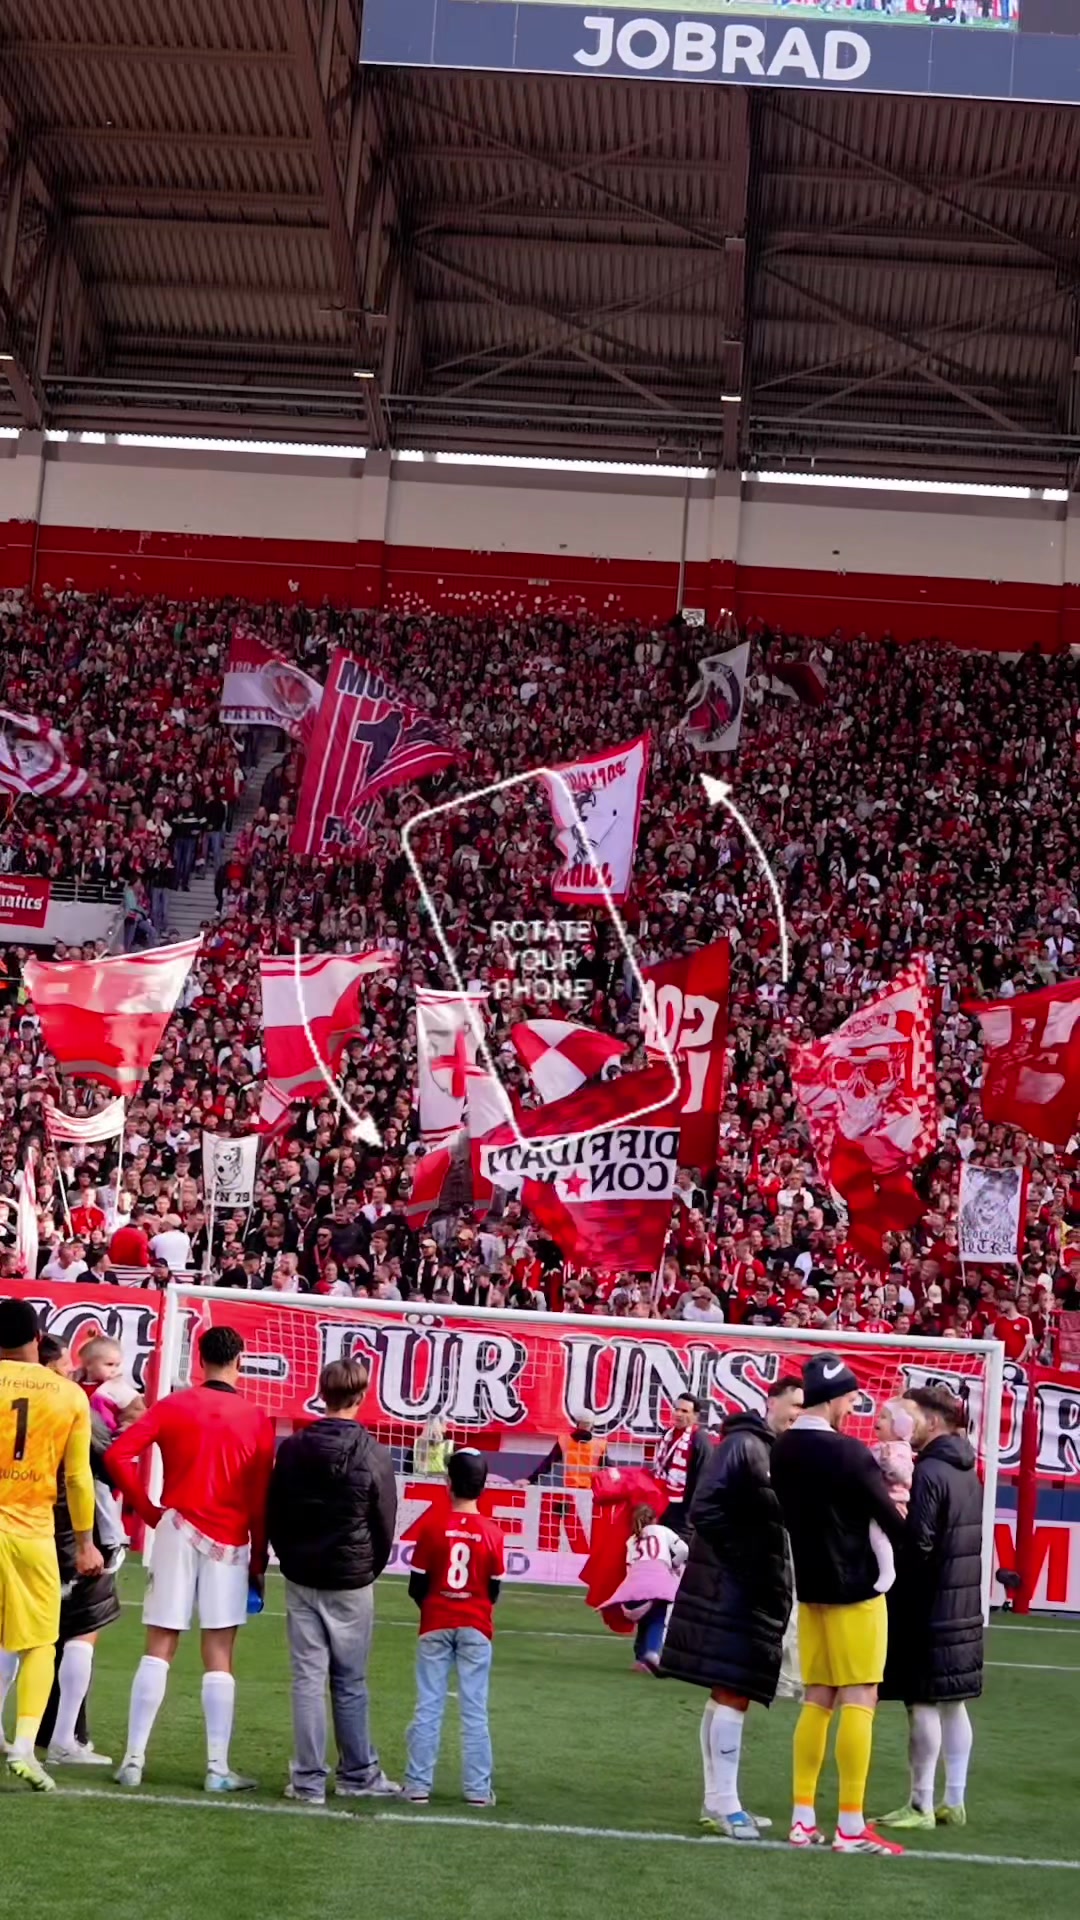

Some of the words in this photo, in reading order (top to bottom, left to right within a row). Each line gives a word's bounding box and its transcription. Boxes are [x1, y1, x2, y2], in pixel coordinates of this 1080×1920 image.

[573, 16, 871, 81] JOBRAD
[303, 1313, 529, 1427] FÜR
[559, 1333, 779, 1439] UNS
[10, 1397, 29, 1461] 1
[446, 1542, 471, 1590] 8
